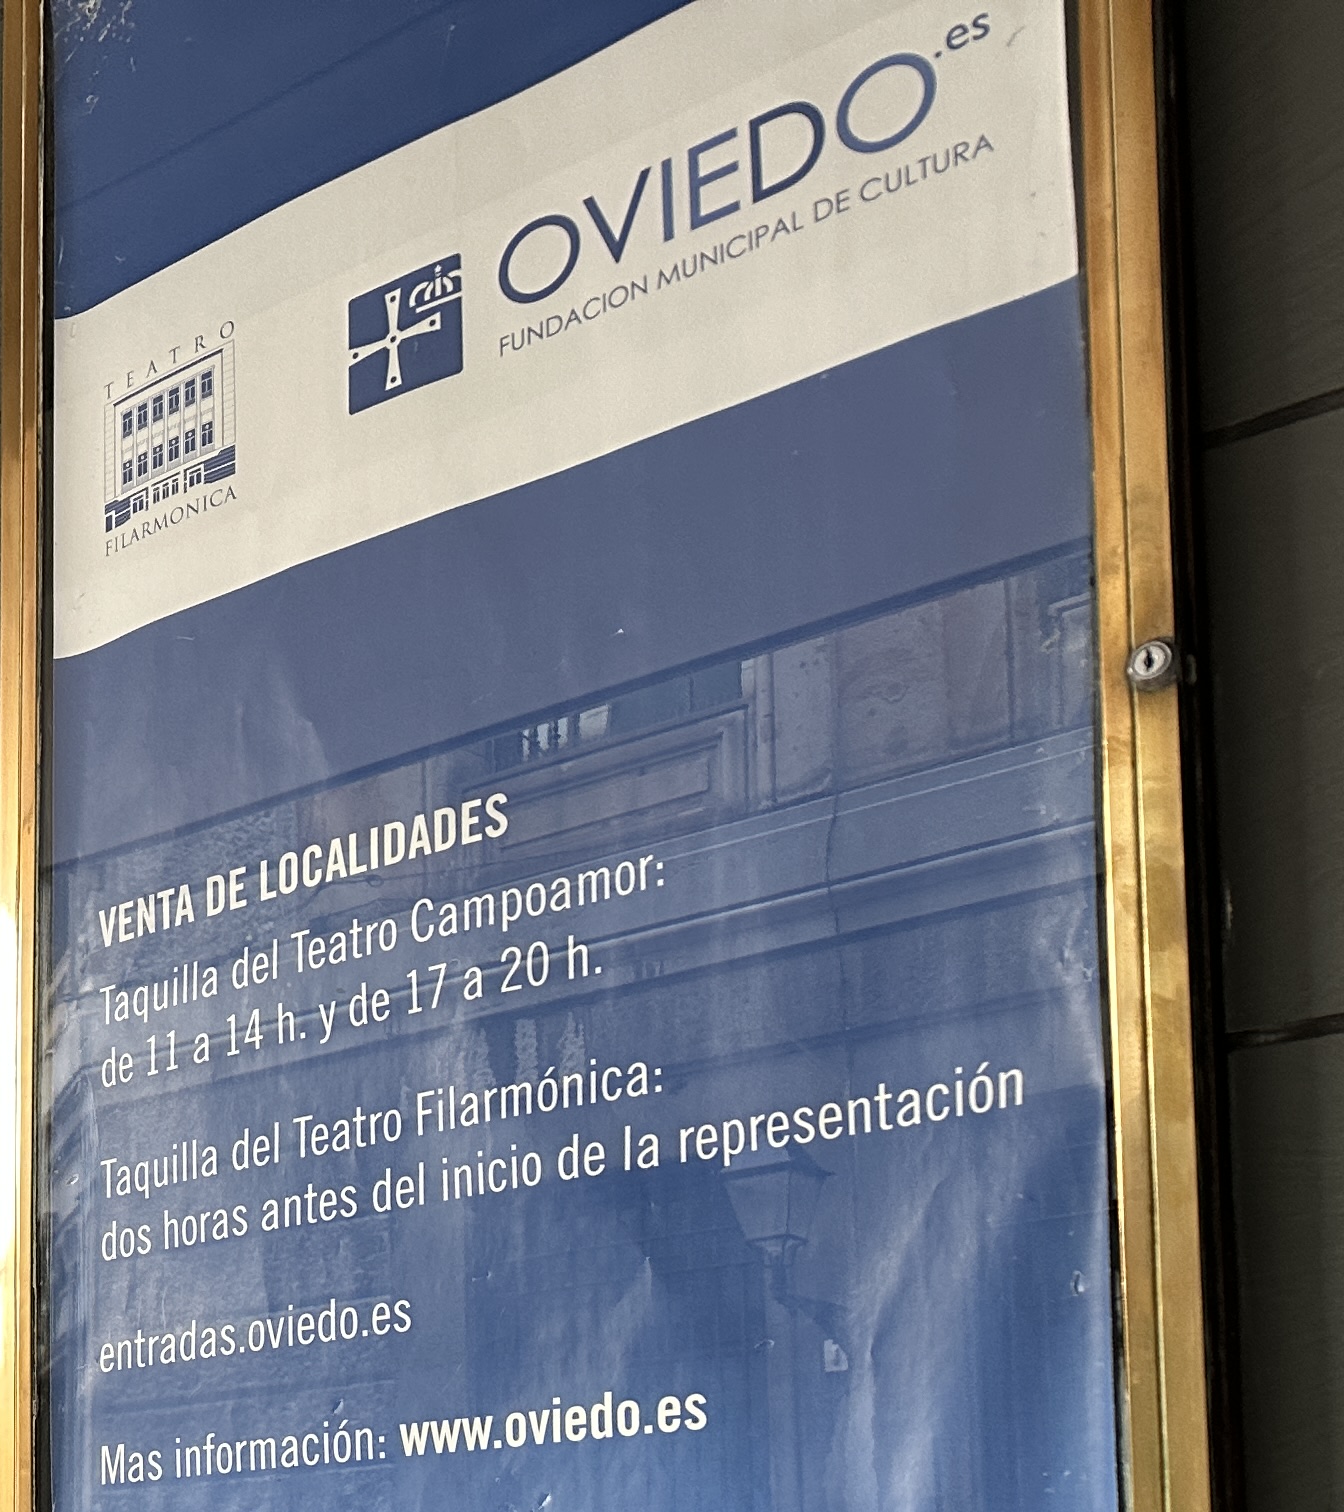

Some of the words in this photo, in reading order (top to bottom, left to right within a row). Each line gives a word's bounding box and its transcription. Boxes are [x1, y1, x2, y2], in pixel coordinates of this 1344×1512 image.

[498, 52, 938, 305] OVIEDO
[498, 275, 649, 358] FUNDACION
[656, 211, 805, 292] MUNICIPAL
[813, 188, 851, 225] DE
[859, 134, 996, 204] CULTURA
[103, 320, 235, 400] TEATRO
[105, 485, 238, 558] FILARMONICA
[98, 886, 196, 948] VENTA
[206, 870, 248, 918] DE
[259, 792, 510, 902] LOCALIDADES
[99, 960, 219, 1026] Taquilla
[231, 938, 279, 990] del
[289, 917, 398, 973] Teatro
[410, 854, 666, 943] Campoamor:
[100, 1045, 134, 1089] de
[146, 1029, 180, 1077] 11
[192, 1032, 211, 1065] a
[224, 1008, 265, 1058] 14
[276, 1002, 307, 1046] h.
[318, 1000, 337, 1046] y
[348, 980, 392, 1028] de
[405, 962, 448, 1016] 17
[462, 966, 485, 1002] a
[499, 940, 551, 994] 20
[566, 934, 603, 981] h.
[99, 1138, 219, 1200] Taquilla
[231, 1121, 281, 1172] del
[291, 1106, 403, 1160] Teatro
[415, 1057, 664, 1138] Filarmónica:
[100, 1219, 152, 1263] dos
[162, 1205, 249, 1251] horas
[260, 1182, 359, 1233] antes
[371, 1160, 426, 1214] del
[440, 1143, 543, 1203] inicio
[556, 1132, 607, 1182] de
[623, 1125, 661, 1172] la
[678, 1060, 1025, 1168] representación
[98, 1297, 413, 1374] entradas.oviedo.es
[100, 1442, 164, 1487] Mas
[174, 1417, 387, 1480] información:
[398, 1390, 709, 1458] www.oviedo.es
